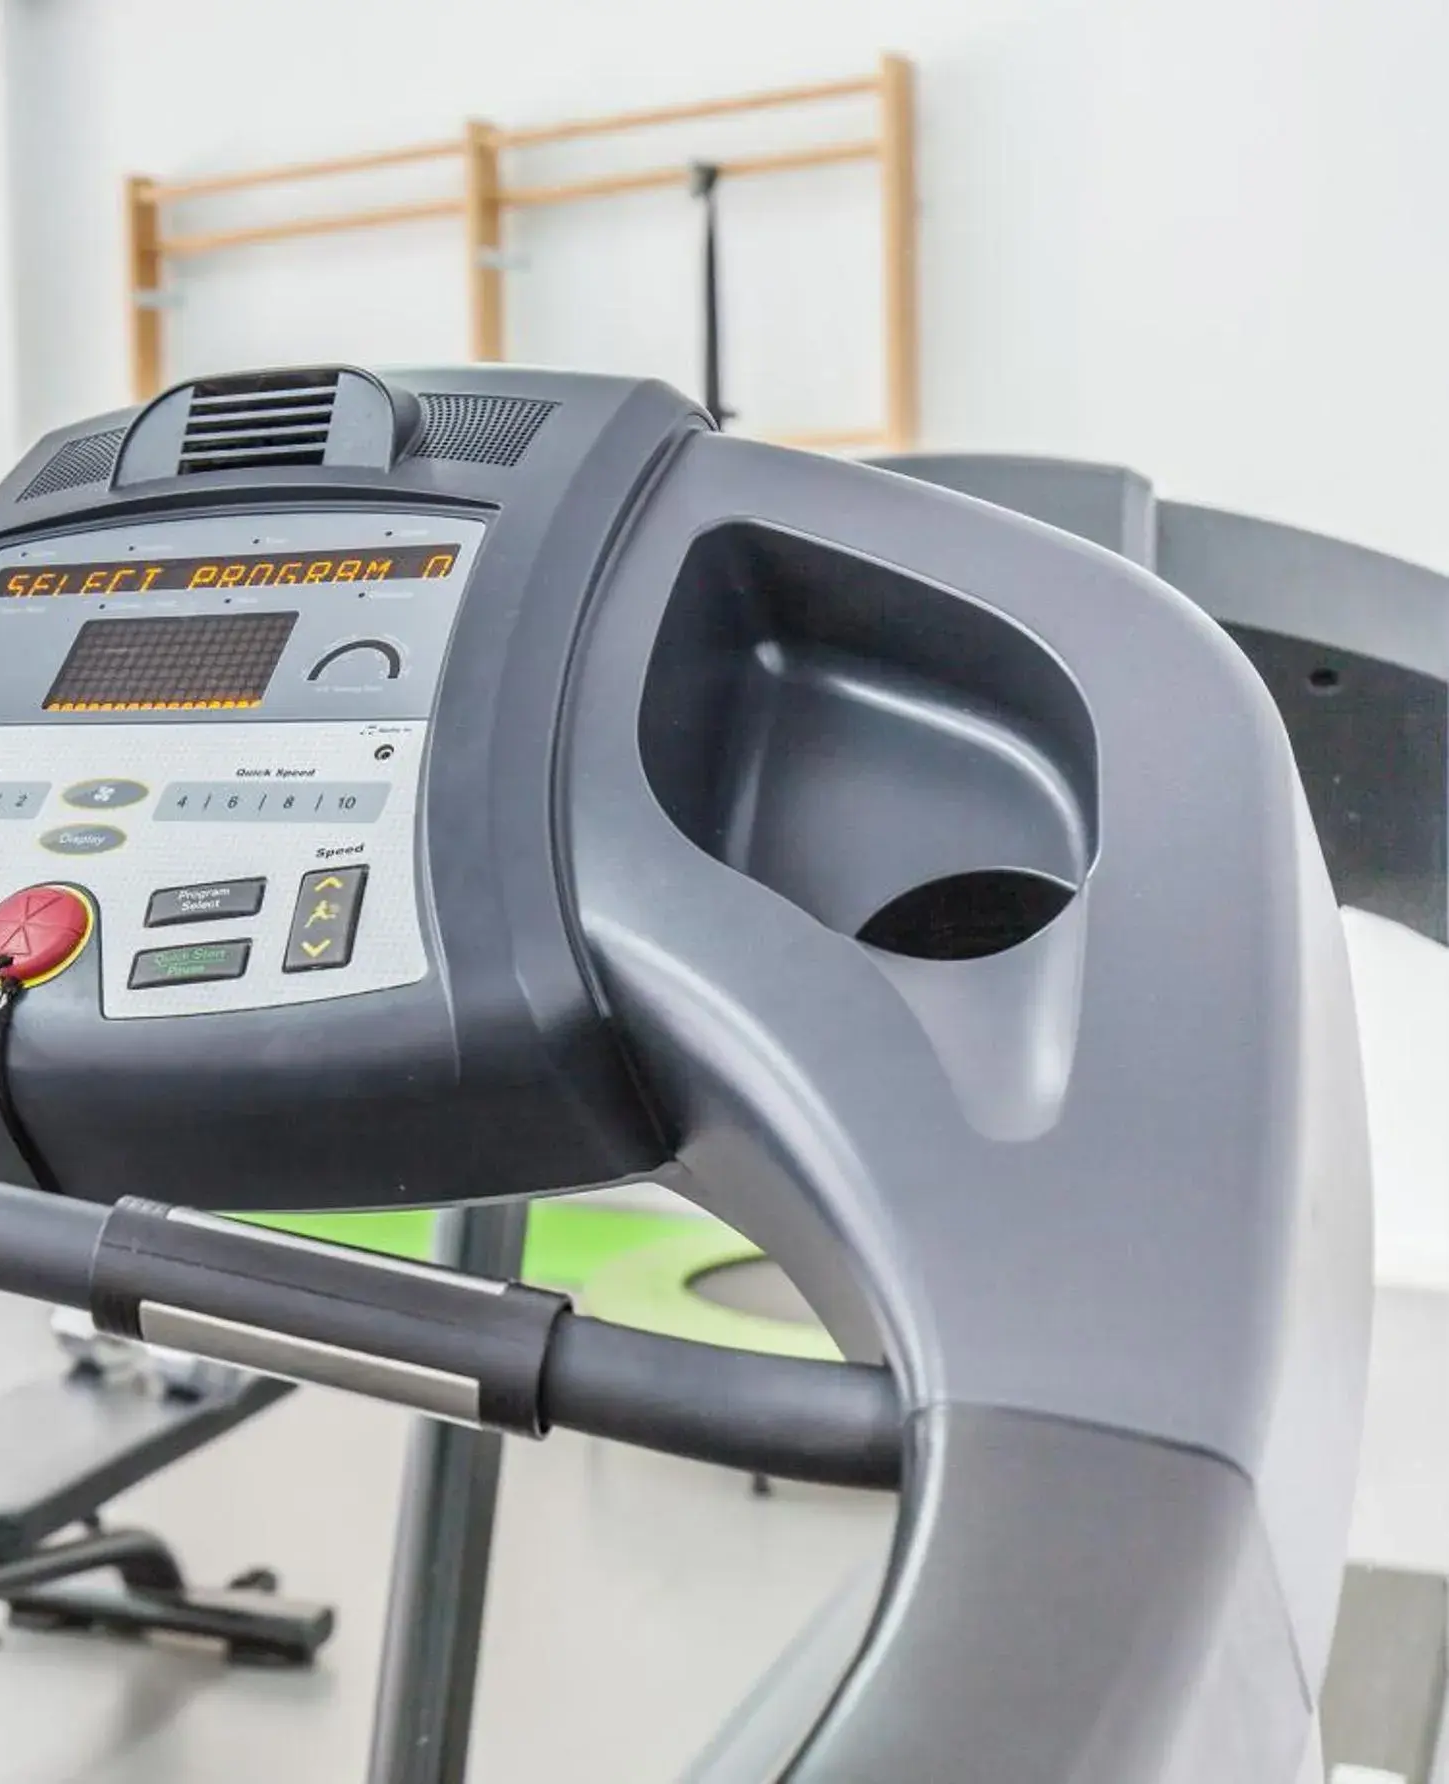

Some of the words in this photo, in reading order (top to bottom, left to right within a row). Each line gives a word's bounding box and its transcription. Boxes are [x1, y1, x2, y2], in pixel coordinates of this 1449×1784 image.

[187, 557, 393, 591] PROGRAM
[236, 768, 271, 777] Quick
[275, 767, 317, 778] Speed
[177, 795, 187, 807] 4
[227, 795, 238, 808] 6
[283, 795, 294, 808] 8
[338, 795, 356, 809] 10
[315, 843, 365, 858] Speed
[178, 888, 230, 900] Program
[181, 900, 221, 911] Select
